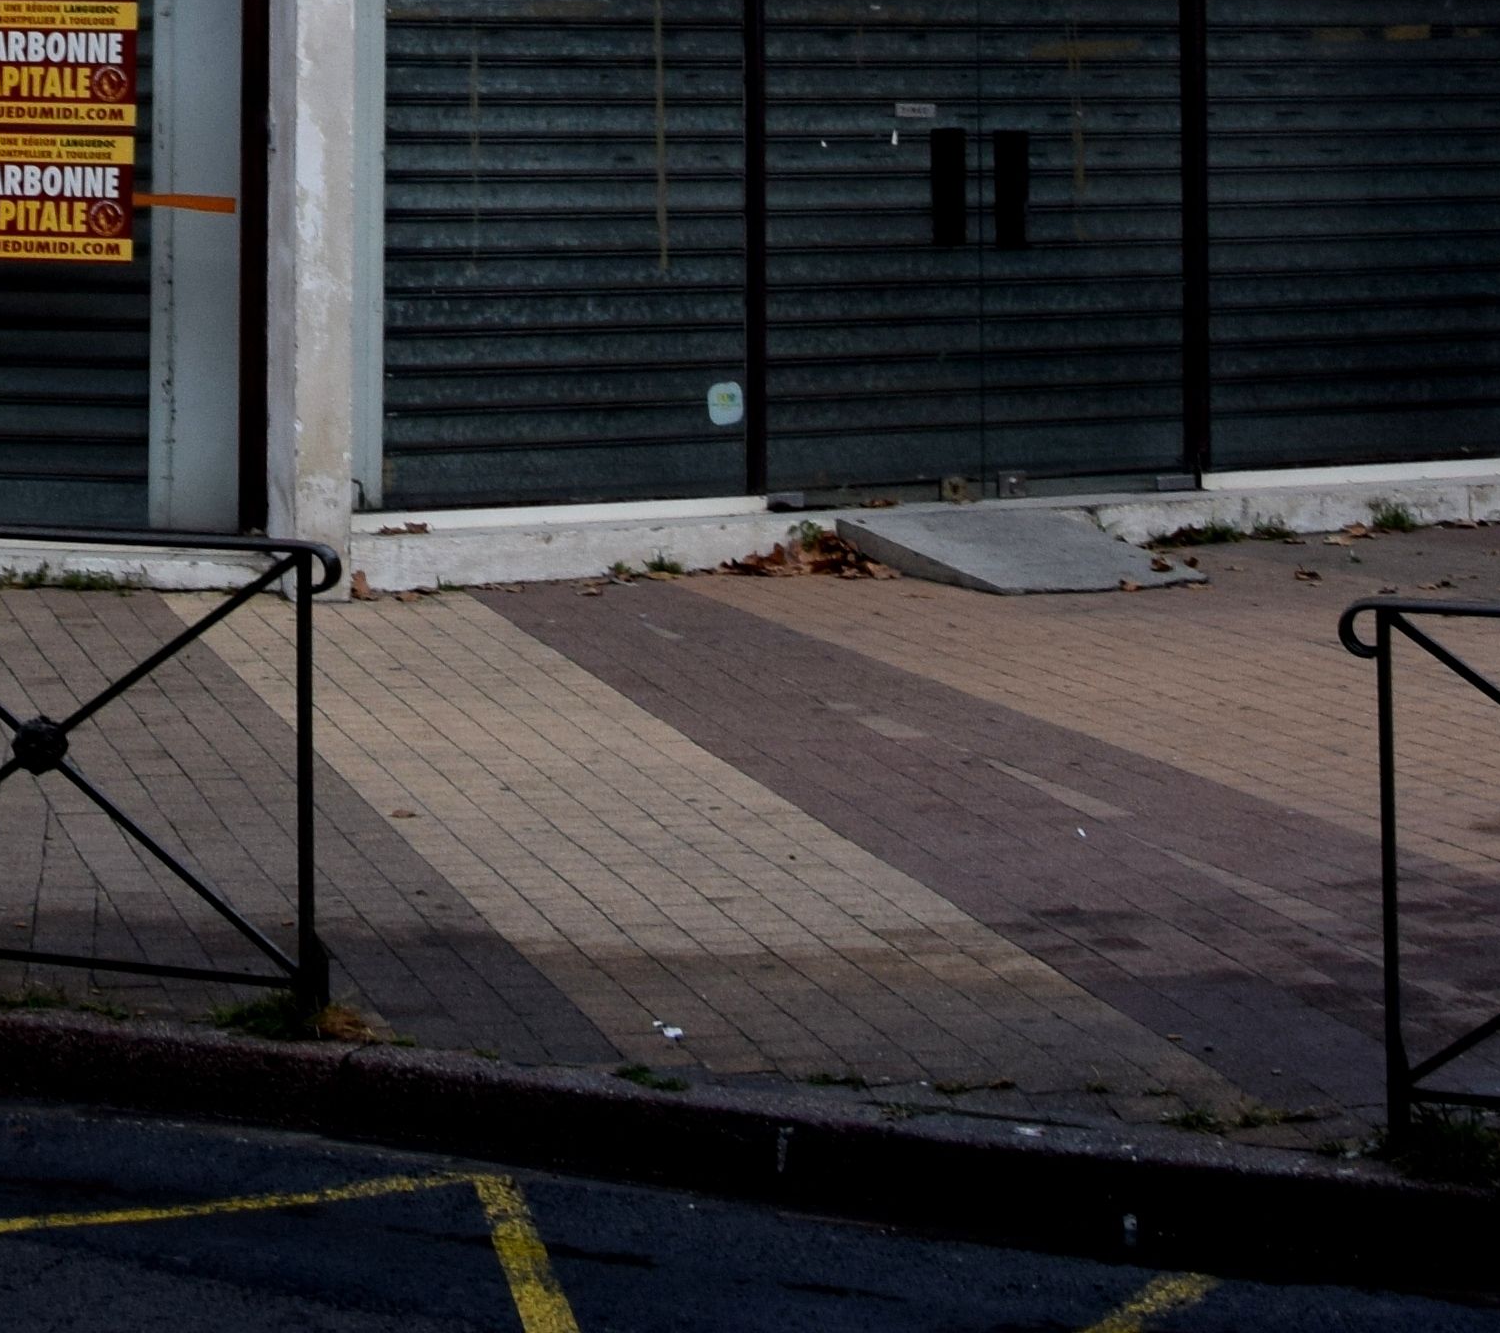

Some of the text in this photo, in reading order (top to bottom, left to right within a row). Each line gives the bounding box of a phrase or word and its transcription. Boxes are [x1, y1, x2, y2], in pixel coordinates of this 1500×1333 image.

[4, 4, 22, 12] UNE
[64, 5, 120, 14] LANGUEDOC
[69, 17, 115, 25] TOULOUSE
[0, 137, 18, 145] UNE
[60, 138, 116, 148] LANGUEDOC
[66, 150, 112, 159] TOULOUSE
